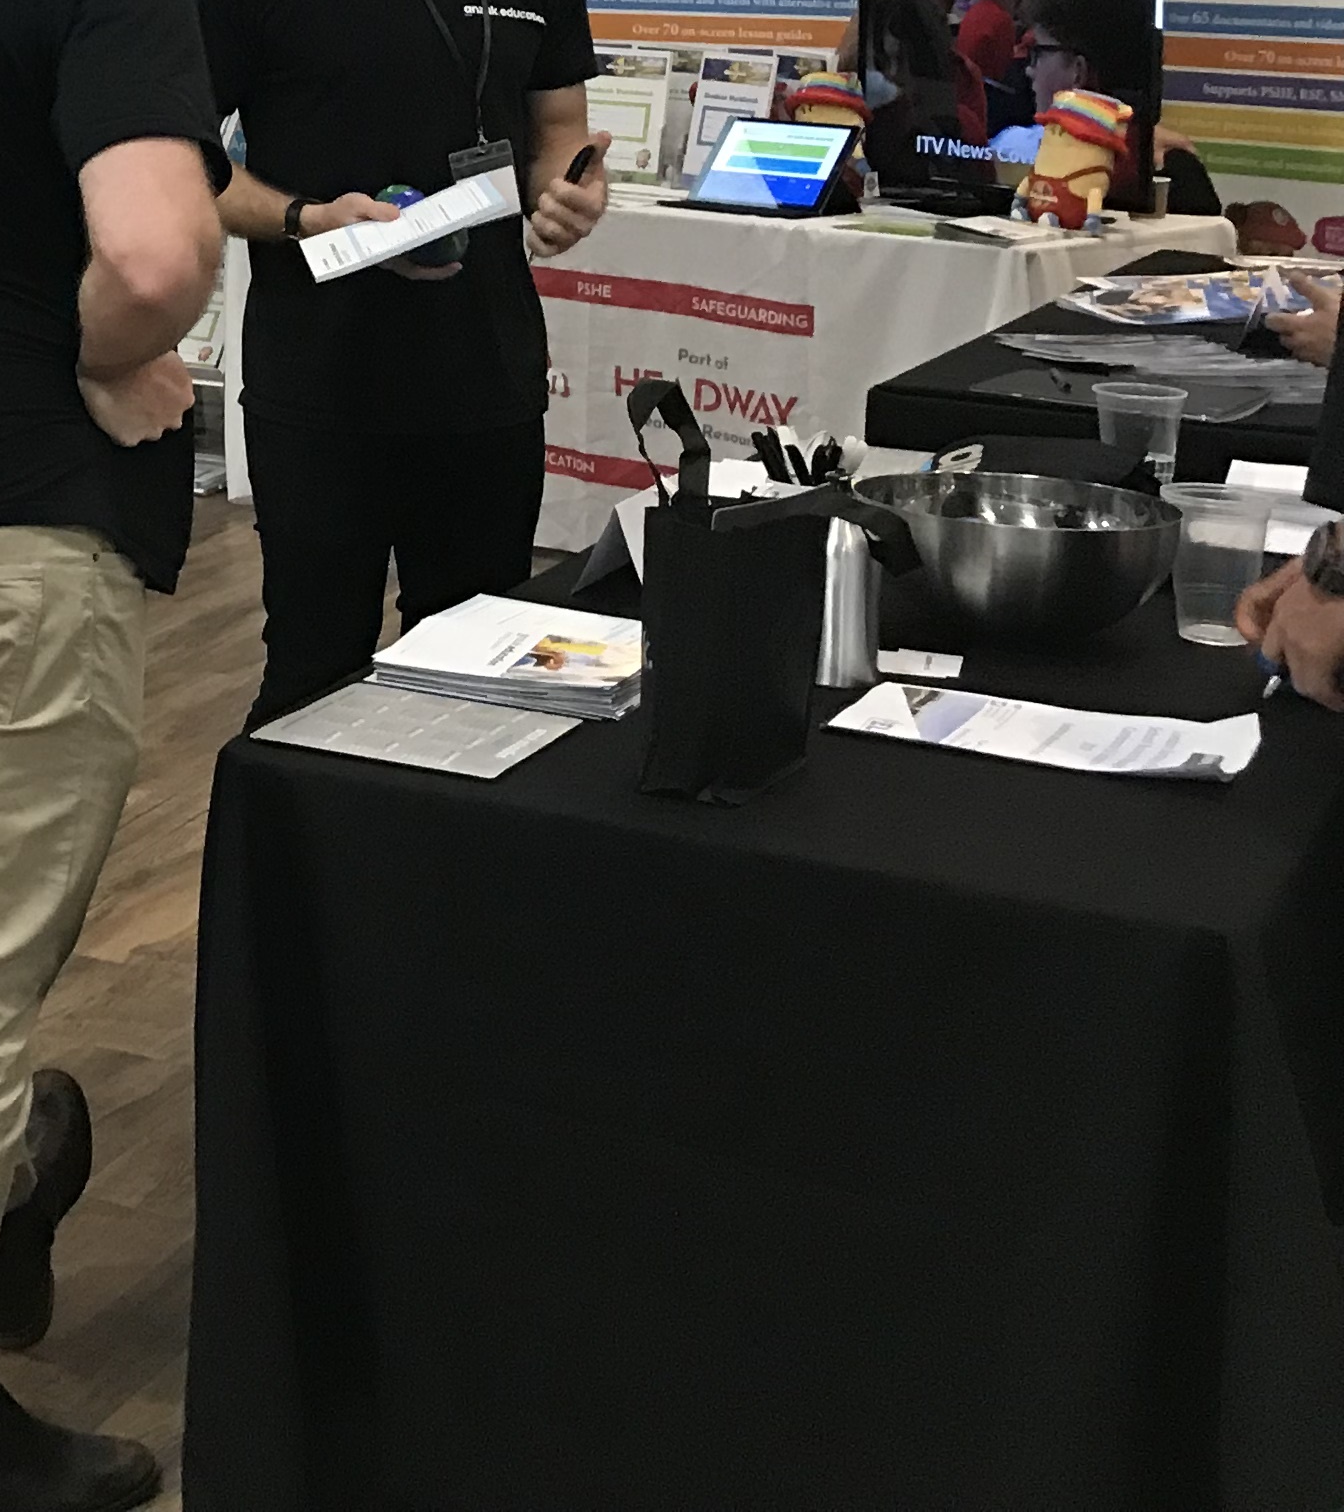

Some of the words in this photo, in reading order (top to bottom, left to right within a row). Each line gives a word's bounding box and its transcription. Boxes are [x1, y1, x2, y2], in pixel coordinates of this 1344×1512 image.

[632, 25, 661, 36] Over
[663, 23, 679, 36] 70
[738, 27, 774, 40] lesson
[775, 28, 813, 41] guides
[1224, 50, 1256, 63] Over
[1202, 82, 1258, 99] Supports
[916, 135, 944, 155] ITV
[947, 138, 993, 161] News
[577, 281, 612, 298] PSHE
[691, 296, 809, 329] SAFEGUARDING
[677, 348, 712, 366] Part
[714, 355, 729, 370] of
